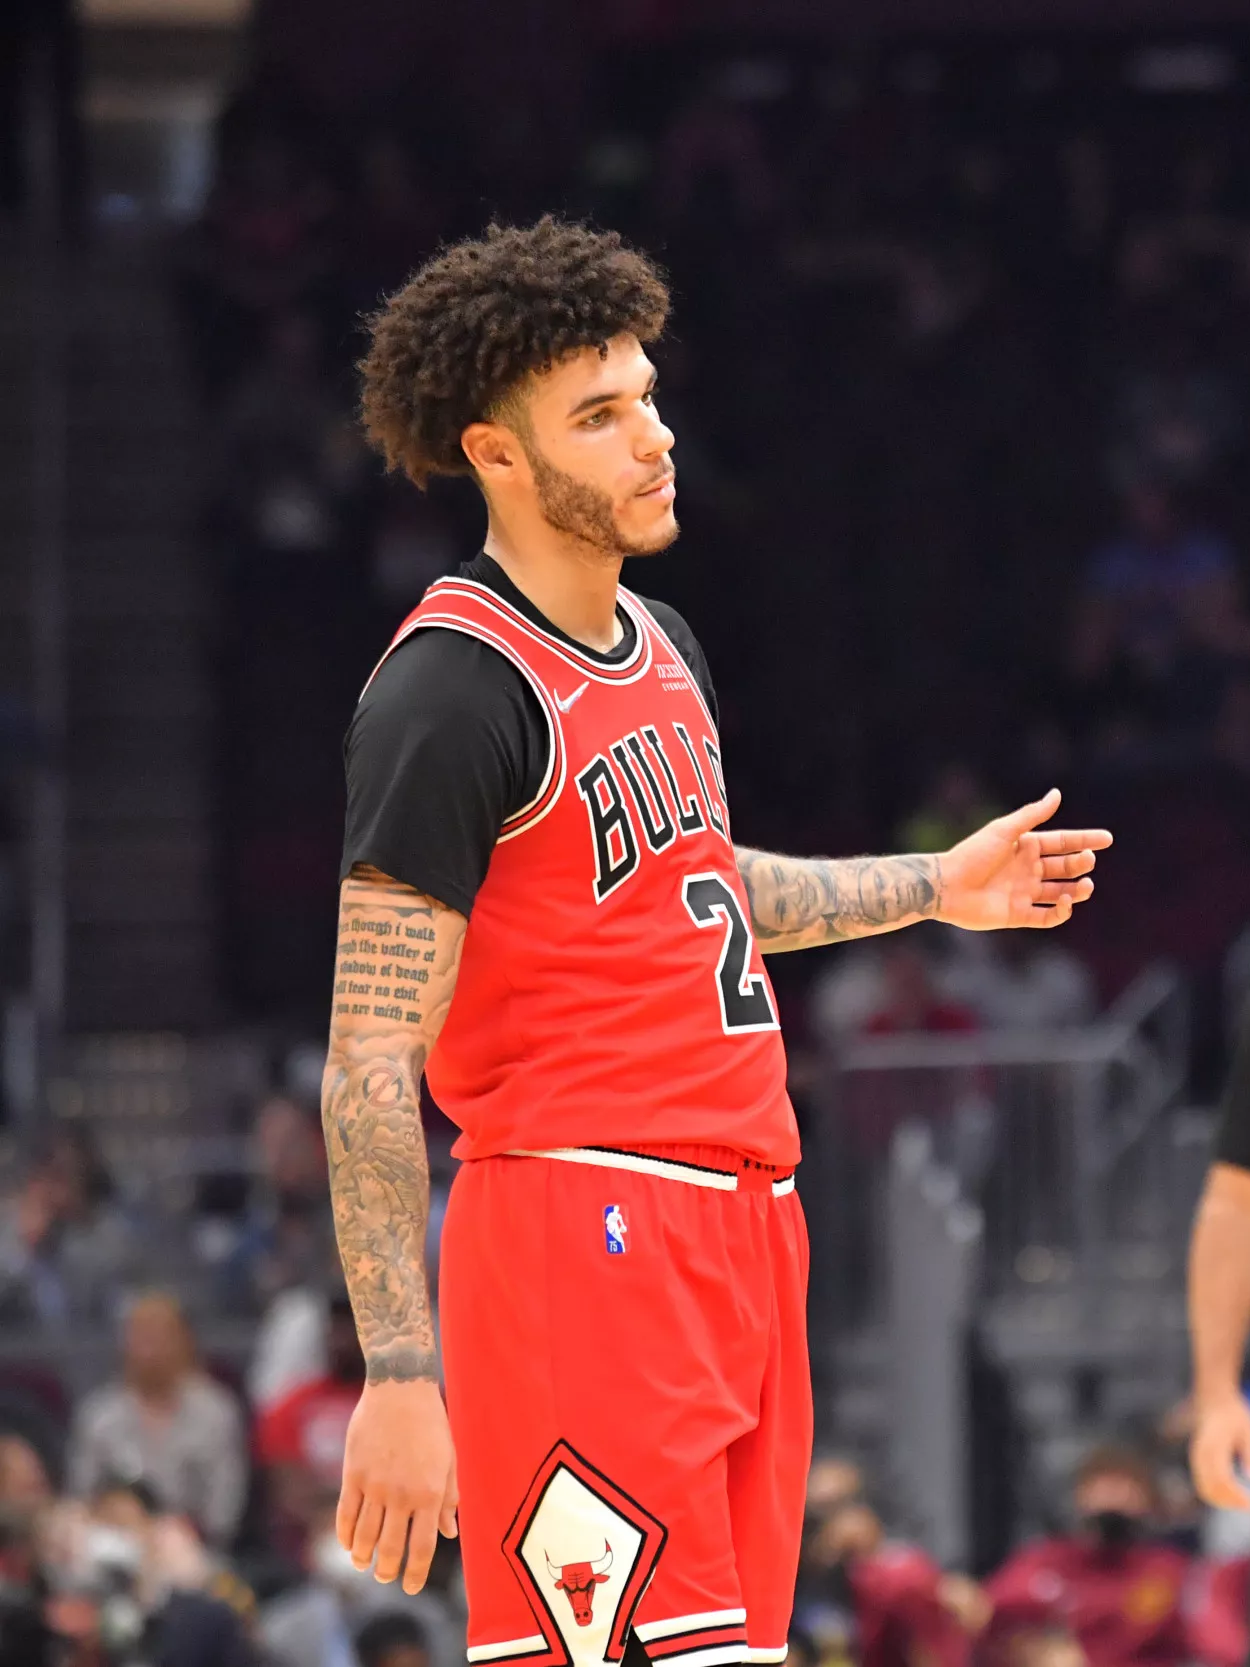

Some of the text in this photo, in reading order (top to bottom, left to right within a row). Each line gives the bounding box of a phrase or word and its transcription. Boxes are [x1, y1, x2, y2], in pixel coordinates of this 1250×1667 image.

[351, 918, 392, 936] though
[405, 925, 435, 941] walk
[359, 939, 378, 954] the
[381, 944, 420, 961] valley
[424, 949, 436, 962] of
[681, 871, 781, 1035] 2
[381, 964, 392, 977] of
[396, 964, 429, 984] death
[348, 980, 372, 995] fear
[375, 986, 390, 996] no
[373, 1004, 403, 1021] with
